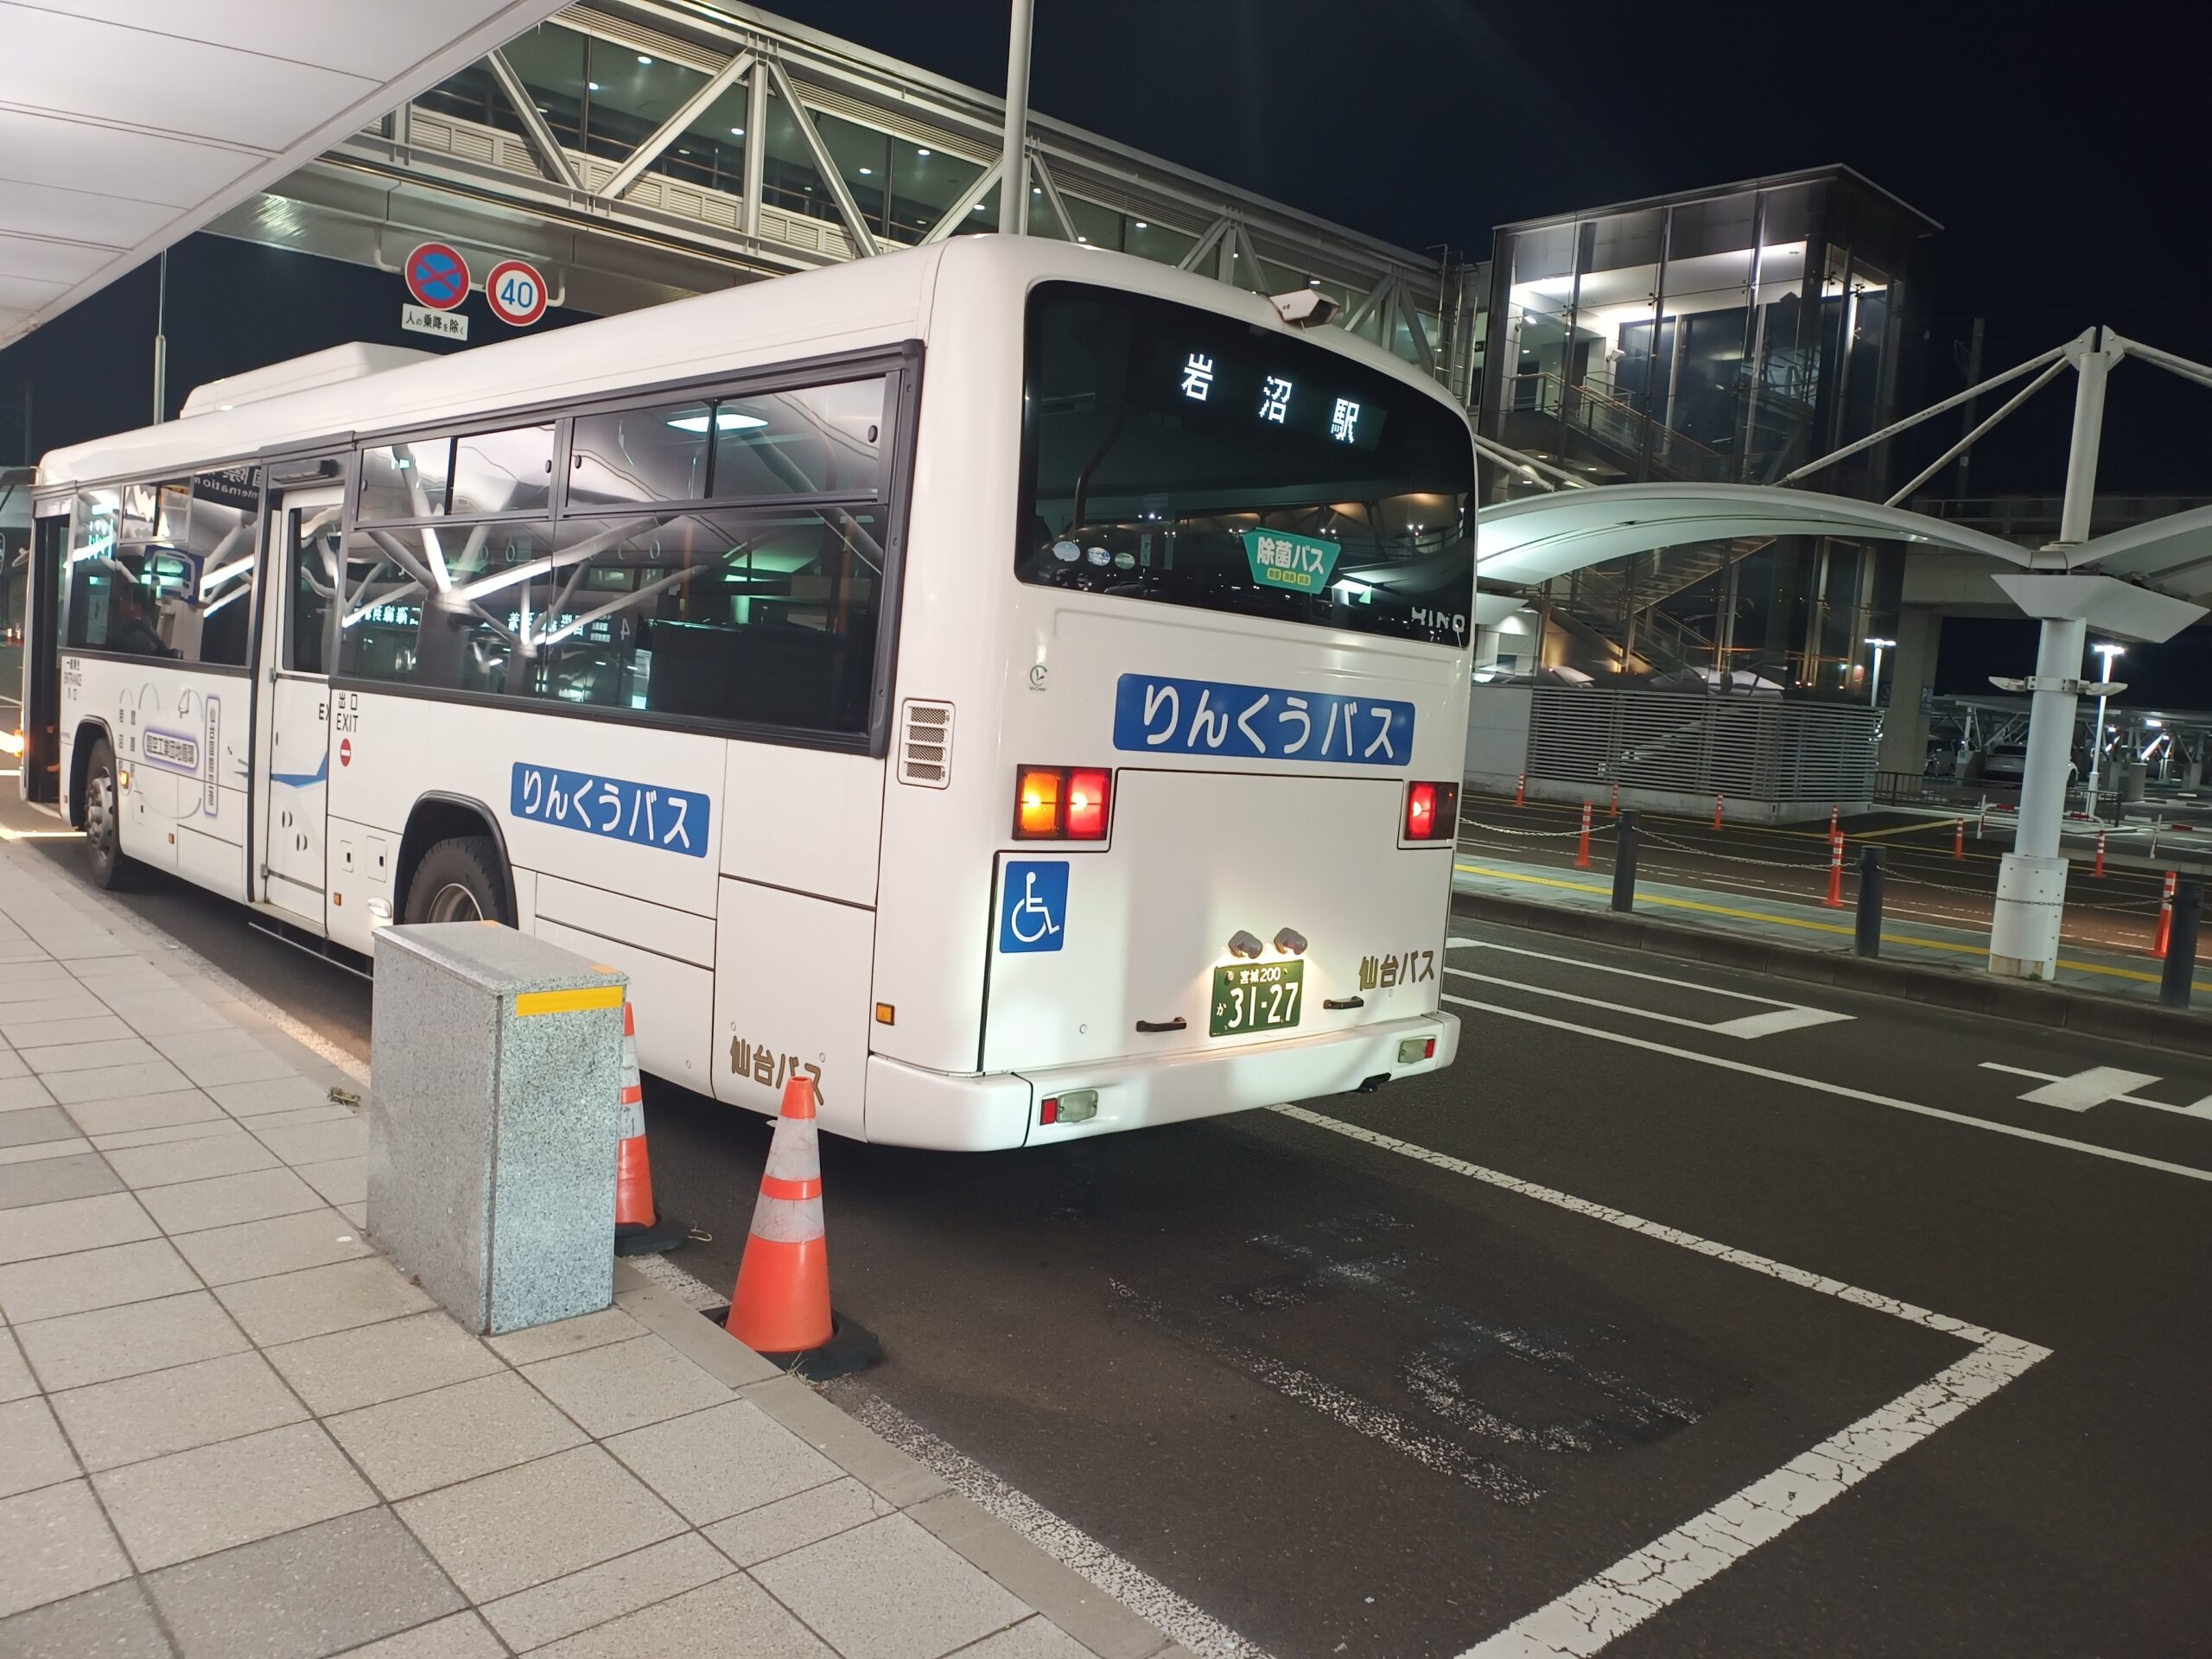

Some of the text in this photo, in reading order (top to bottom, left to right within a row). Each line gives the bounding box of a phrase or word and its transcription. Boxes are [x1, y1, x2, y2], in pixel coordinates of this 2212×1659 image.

[501, 278, 532, 308] 40
[406, 311, 464, 335] 人の乗降を除く
[1257, 537, 1324, 575] 除菌バス
[1411, 607, 1465, 633] HINO
[338, 691, 358, 710] 出口
[336, 713, 359, 733] EXIT
[1143, 684, 1394, 759] りんくうバス
[524, 770, 690, 849] りんくうバス
[1358, 950, 1434, 991] 仙台バス
